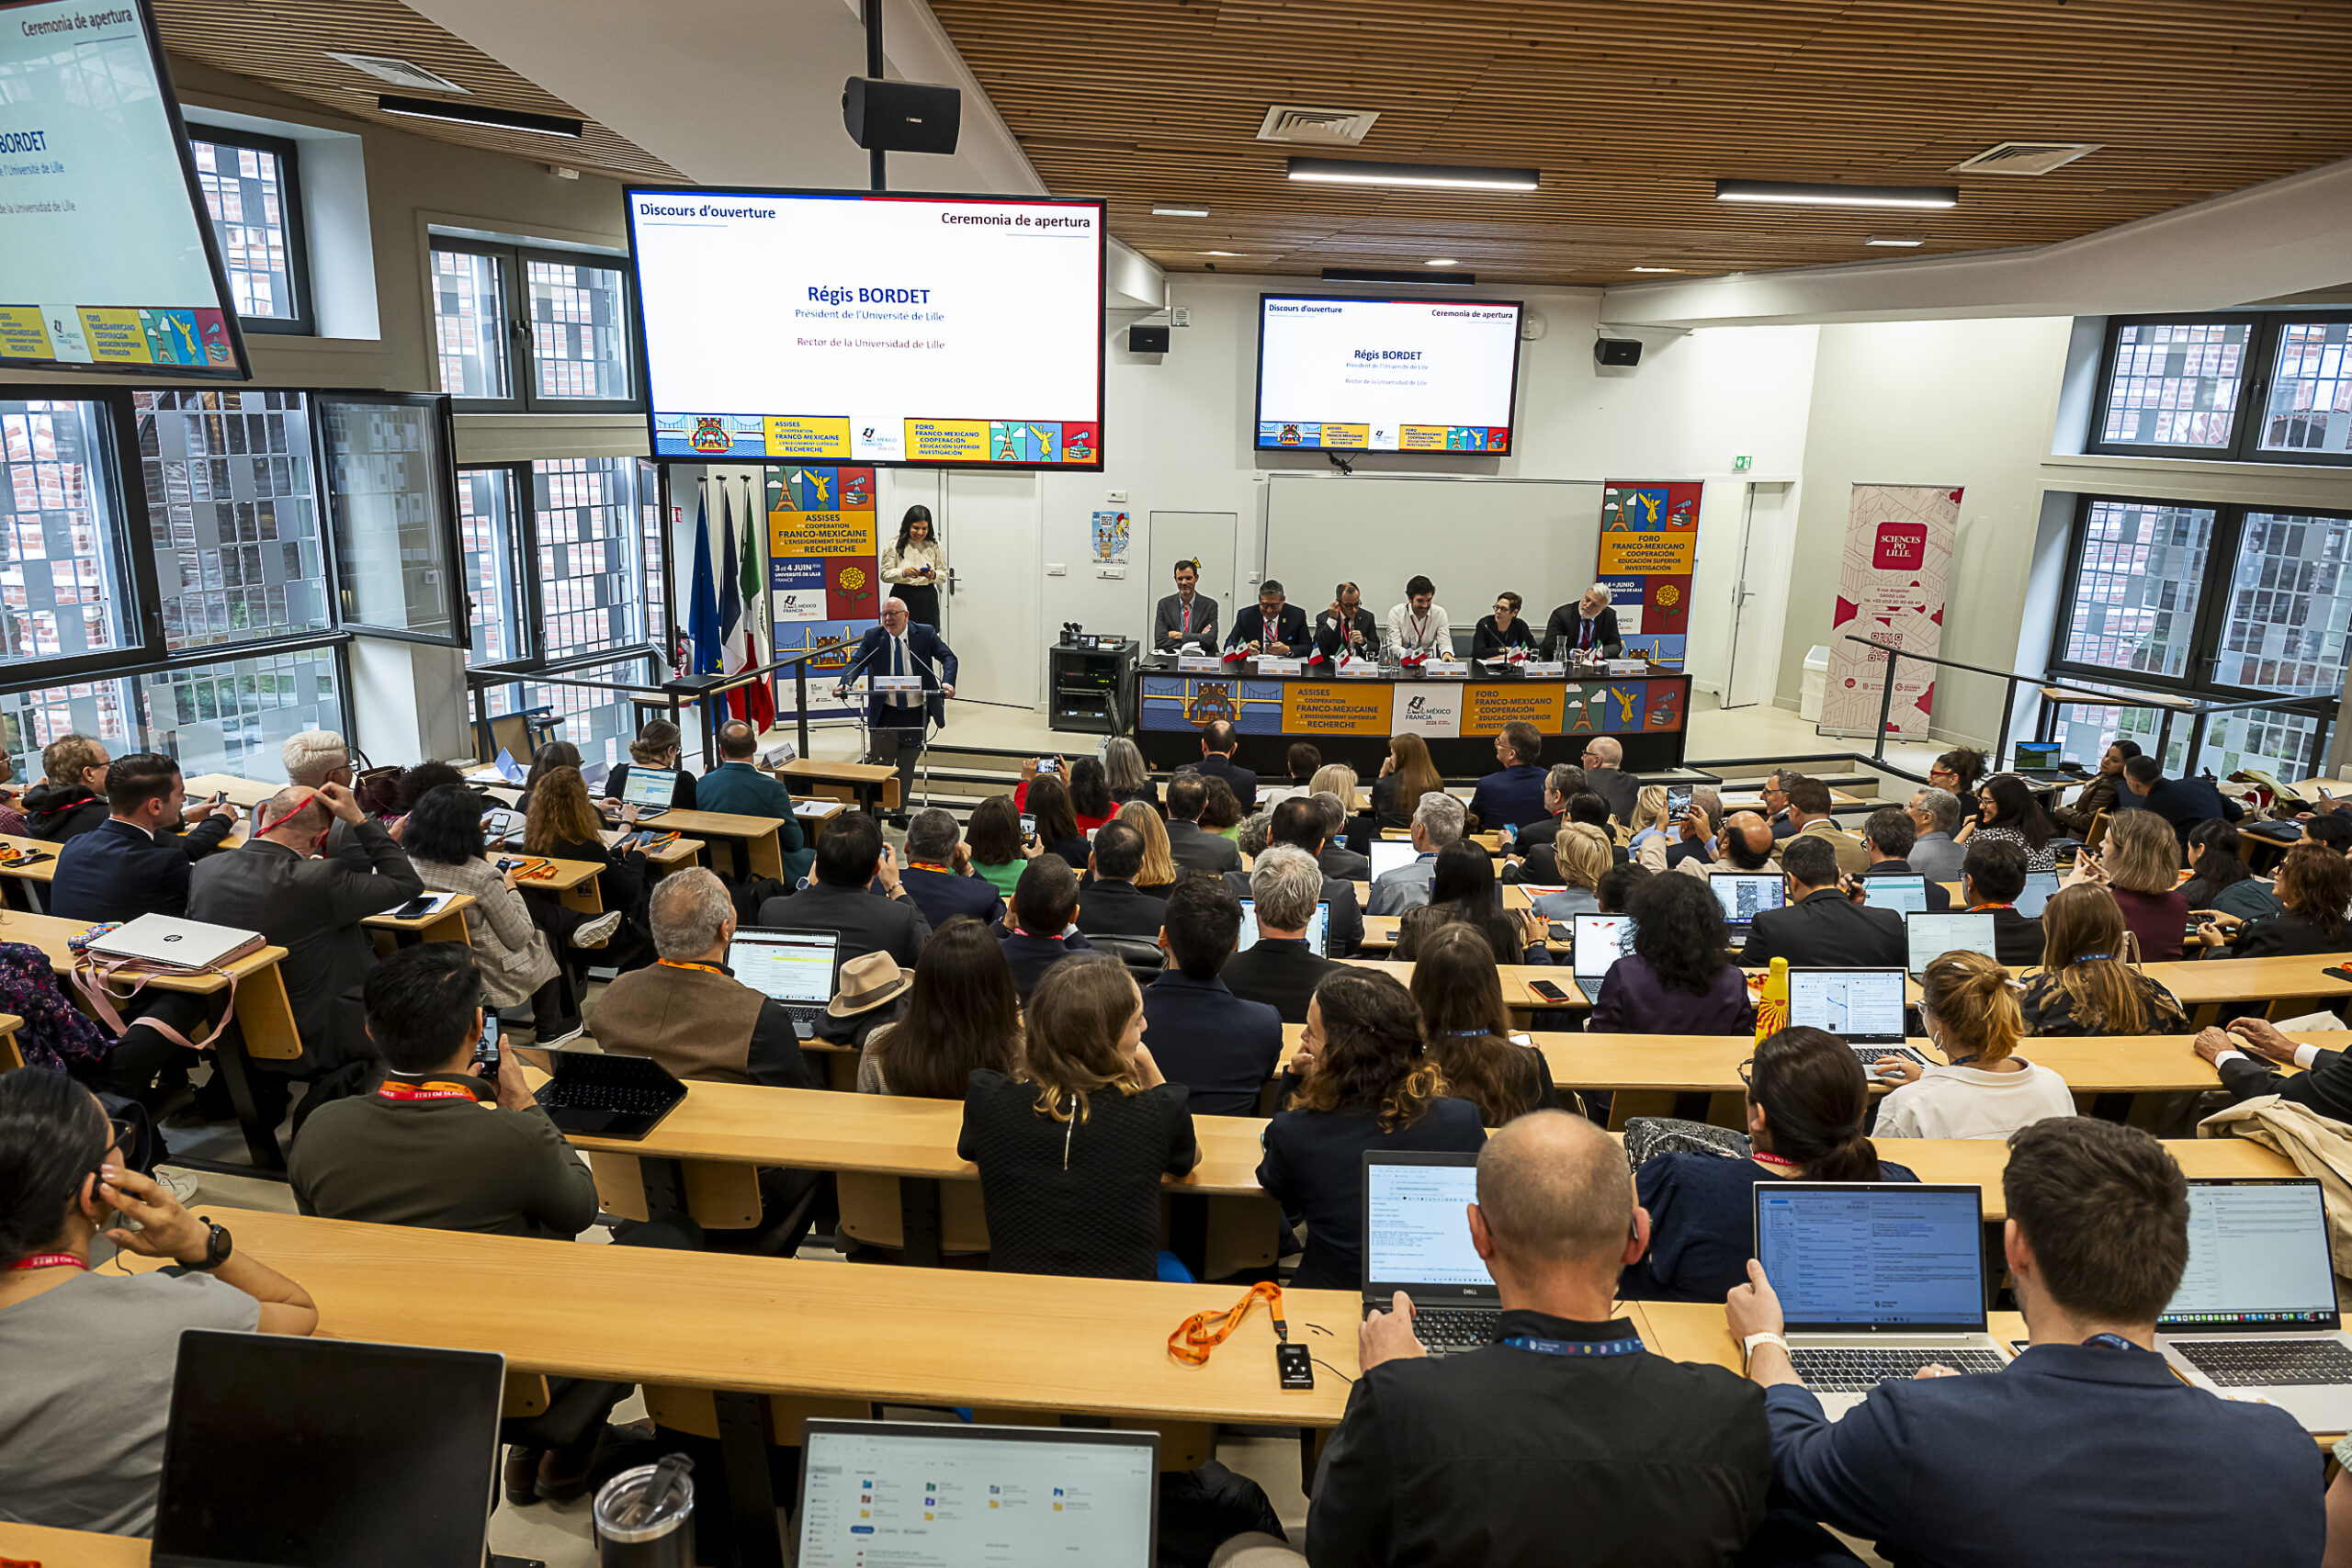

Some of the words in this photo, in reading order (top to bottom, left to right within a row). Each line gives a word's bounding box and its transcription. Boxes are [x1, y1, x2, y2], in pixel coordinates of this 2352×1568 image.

[21, 15, 74, 37] Ceremonia
[74, 12, 87, 29] de
[89, 8, 133, 30] apertura
[41, 162, 51, 174] de
[51, 160, 64, 174] Lille
[15, 200, 51, 213] Universidad
[52, 200, 62, 211] de
[62, 199, 75, 211] Lille
[640, 203, 695, 217] Discours
[699, 205, 775, 219] d'ouverture
[942, 212, 1011, 226] Ceremonia
[1015, 214, 1031, 226] de
[1035, 216, 1091, 229] apertura
[808, 286, 854, 306] Régis
[859, 288, 931, 304] BORDET
[1301, 305, 1342, 313] d'ouverture
[1431, 309, 1470, 318] Ceremonia
[1483, 311, 1512, 320] apertura
[795, 309, 840, 319] Président
[842, 310, 854, 319] de
[856, 310, 909, 321] l'Université
[911, 312, 923, 321] de
[925, 312, 944, 321] Lille
[797, 337, 828, 346] Rector
[831, 338, 842, 347] de
[844, 338, 853, 347] la
[854, 339, 910, 349] Universidad
[912, 340, 924, 349] de
[926, 341, 945, 350] Lille
[1354, 349, 1380, 361] Régis
[1383, 350, 1422, 360] BORDET
[1881, 536, 1921, 544] SCIENCES
[805, 545, 856, 553] RECHERCHE
[1894, 542, 1906, 550] PO
[1885, 549, 1911, 558] LILLE
[1296, 705, 1378, 713] FRANCO-MEXICAINE
[1479, 705, 1535, 714] COOPERACIÓN
[1478, 713, 1513, 721] EDUCACIÓN
